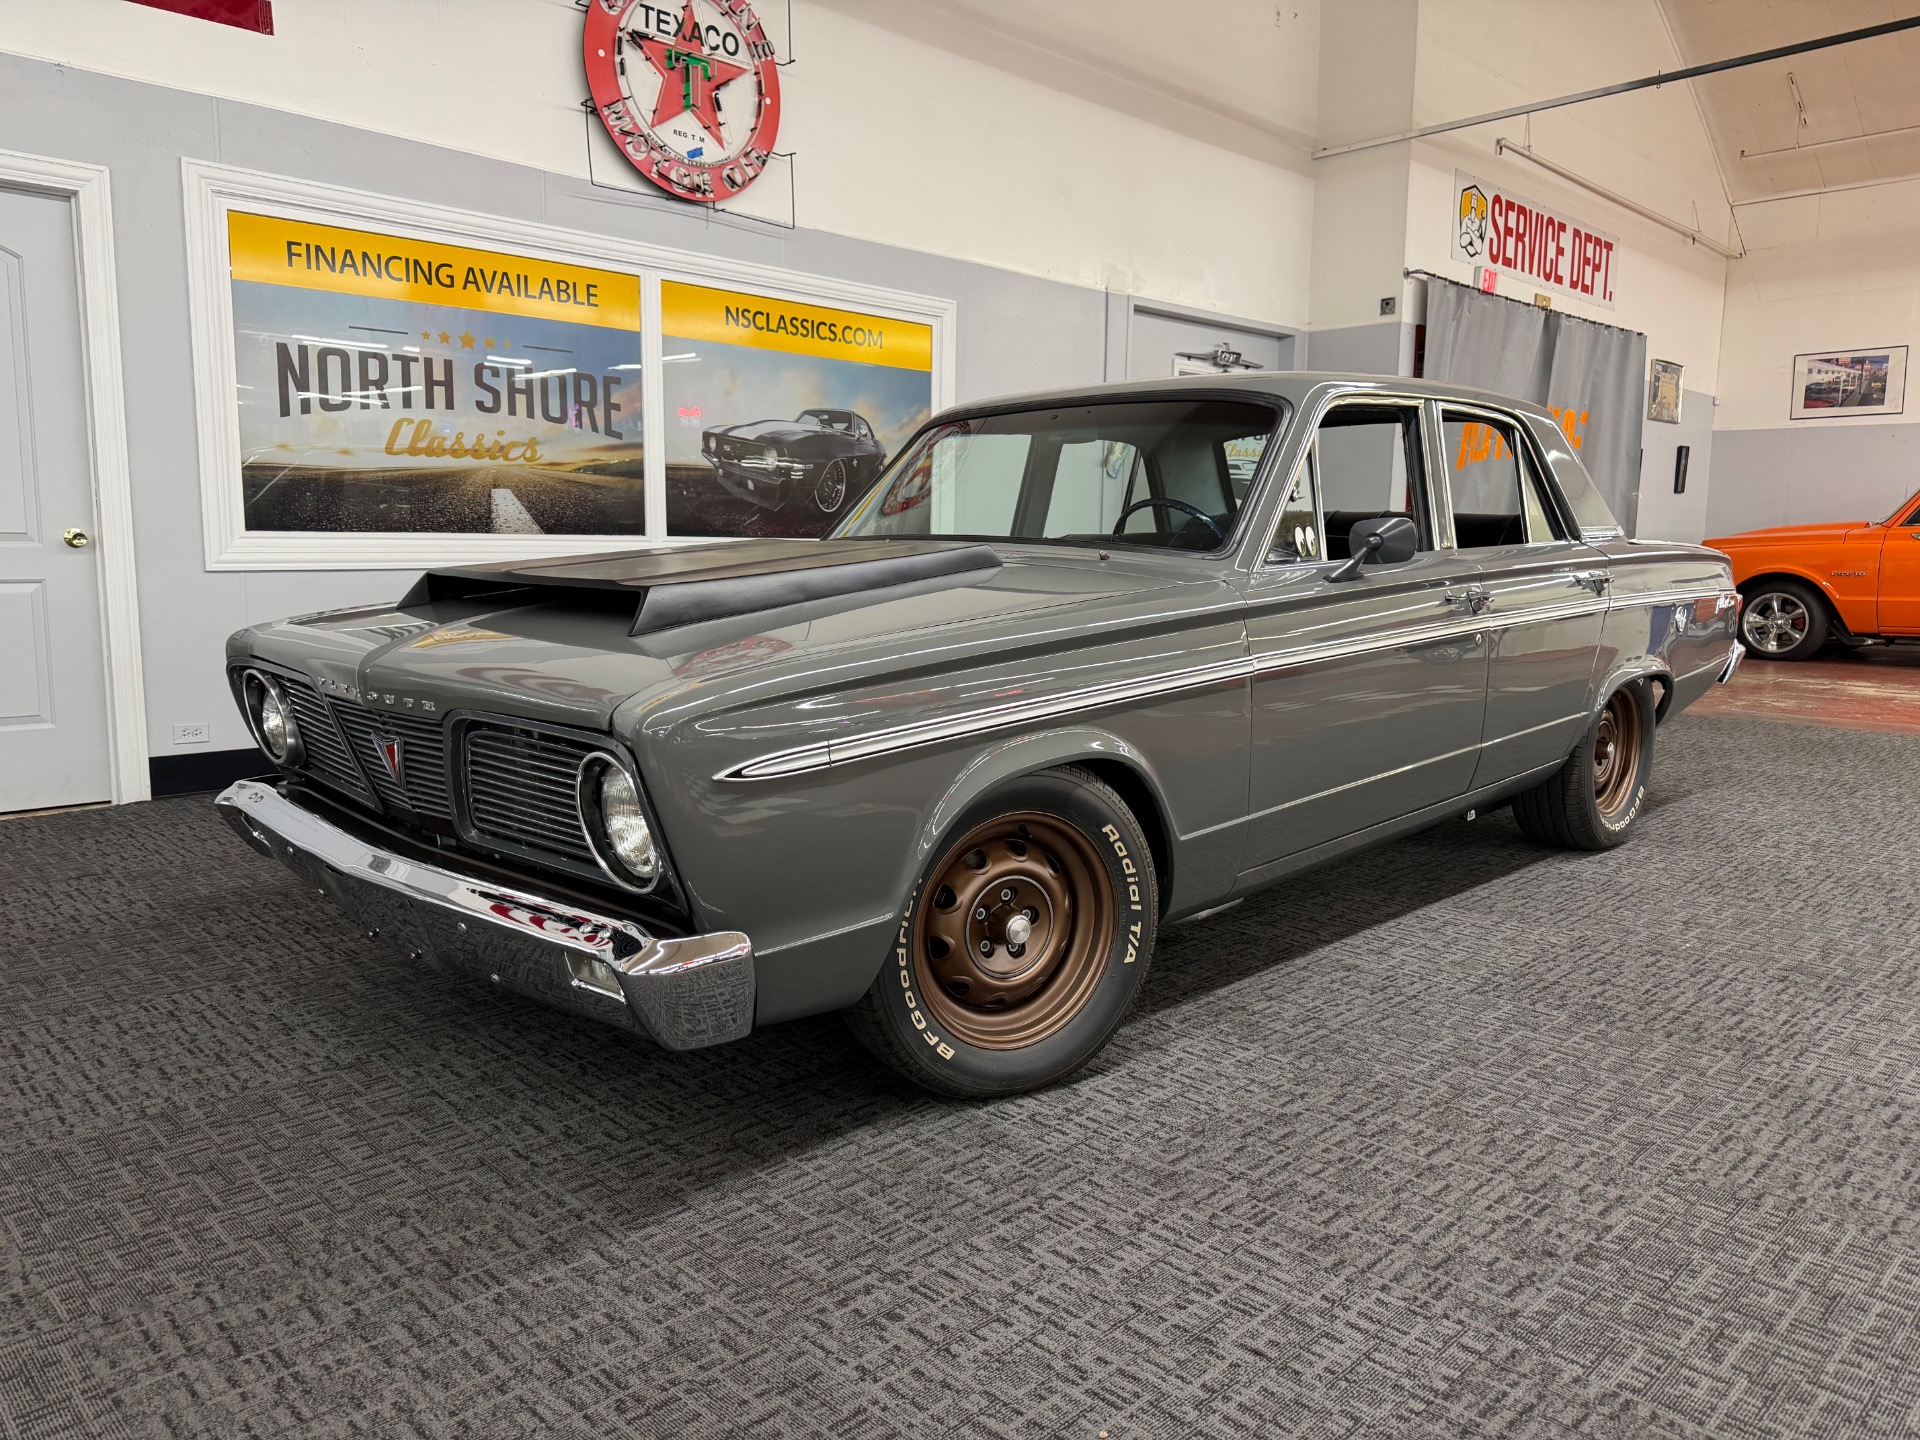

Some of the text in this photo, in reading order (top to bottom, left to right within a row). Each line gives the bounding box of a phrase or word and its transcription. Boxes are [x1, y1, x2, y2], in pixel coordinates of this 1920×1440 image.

[639, 3, 740, 57] TEXACO
[286, 240, 600, 308] FINANCING AVAILABLE
[1488, 193, 1614, 303] SERVICE DEPT.
[1482, 268, 1498, 293] EXIT
[724, 305, 884, 350] NSCLASSICS.COM
[275, 341, 624, 440] NORTH SHORE
[384, 416, 544, 463] Classics
[1101, 823, 1142, 911] Radial
[1123, 921, 1142, 964] T/A
